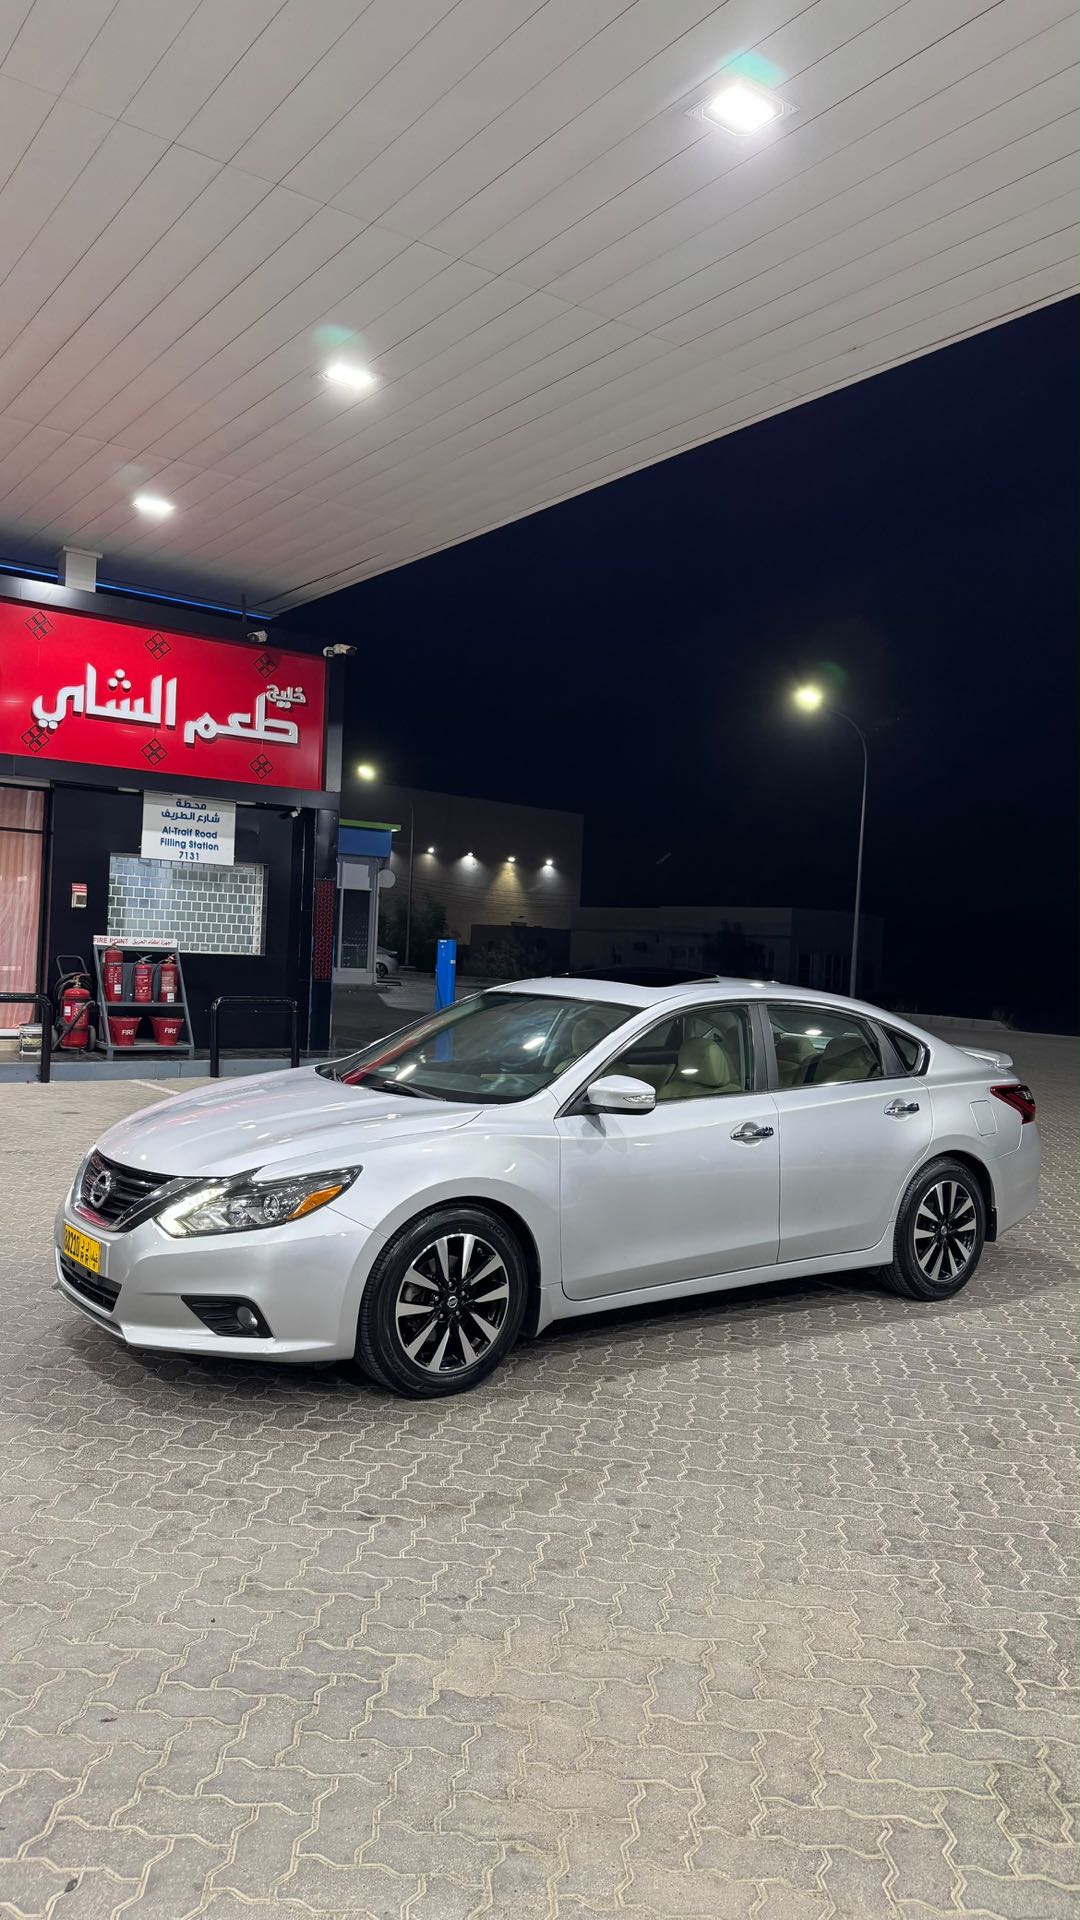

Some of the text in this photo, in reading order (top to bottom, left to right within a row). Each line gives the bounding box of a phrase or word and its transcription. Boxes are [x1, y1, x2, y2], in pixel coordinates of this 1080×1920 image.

[31, 661, 298, 744] طعم الشاي
[266, 684, 306, 708] خليج
[176, 798, 207, 810] محطة
[161, 809, 220, 824] شارع الطريف
[162, 826, 218, 839] Al-Traif Road
[160, 838, 219, 851] Filling Station
[179, 851, 200, 860] 7131
